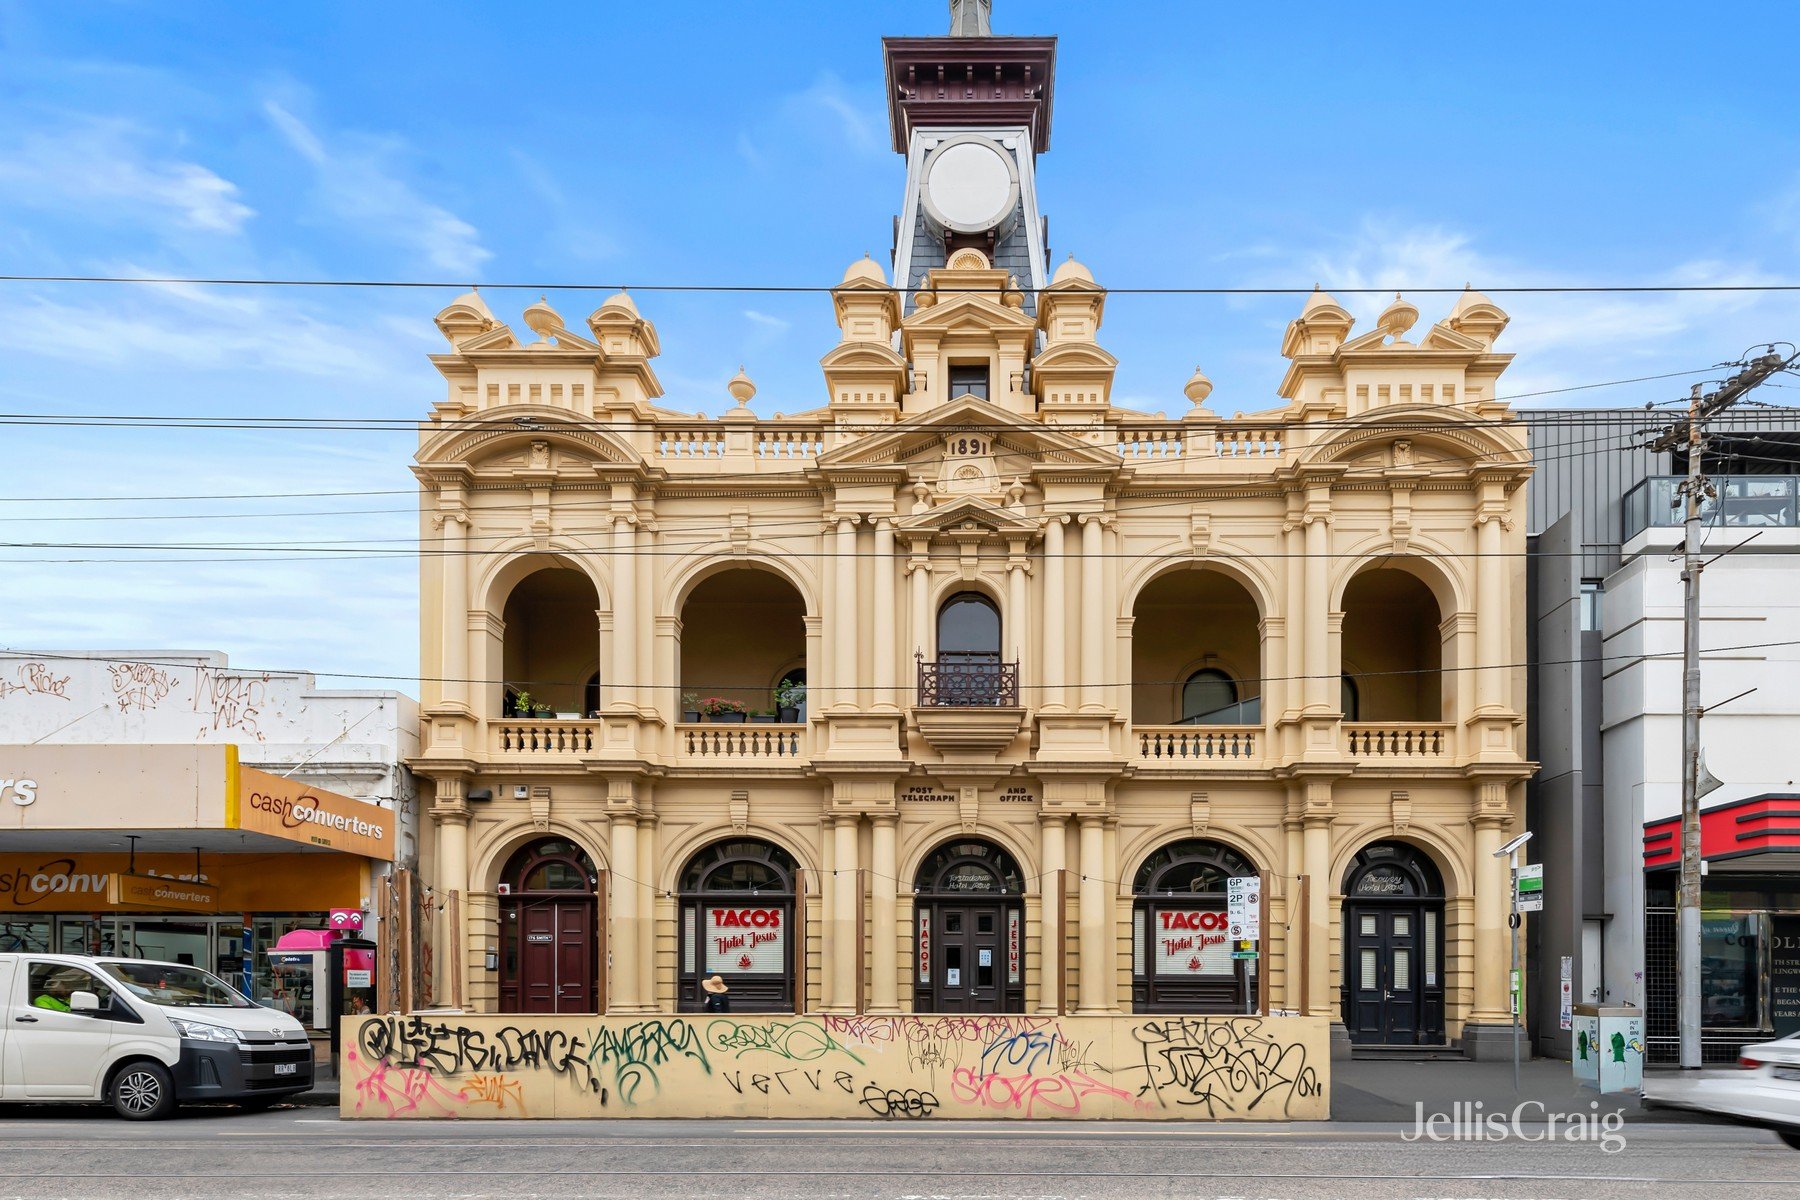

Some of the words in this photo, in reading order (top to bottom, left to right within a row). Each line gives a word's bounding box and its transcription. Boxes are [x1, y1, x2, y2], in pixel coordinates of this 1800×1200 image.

[951, 438, 987, 455] 1891
[901, 794, 955, 802] TELEGRAPH
[1229, 878, 1242, 887] 6P
[1229, 894, 1243, 903] 2P
[712, 909, 780, 927] TACOS
[1160, 912, 1228, 930] TACOS
[920, 919, 929, 971] TACOS
[1010, 920, 1018, 971] JESUS
